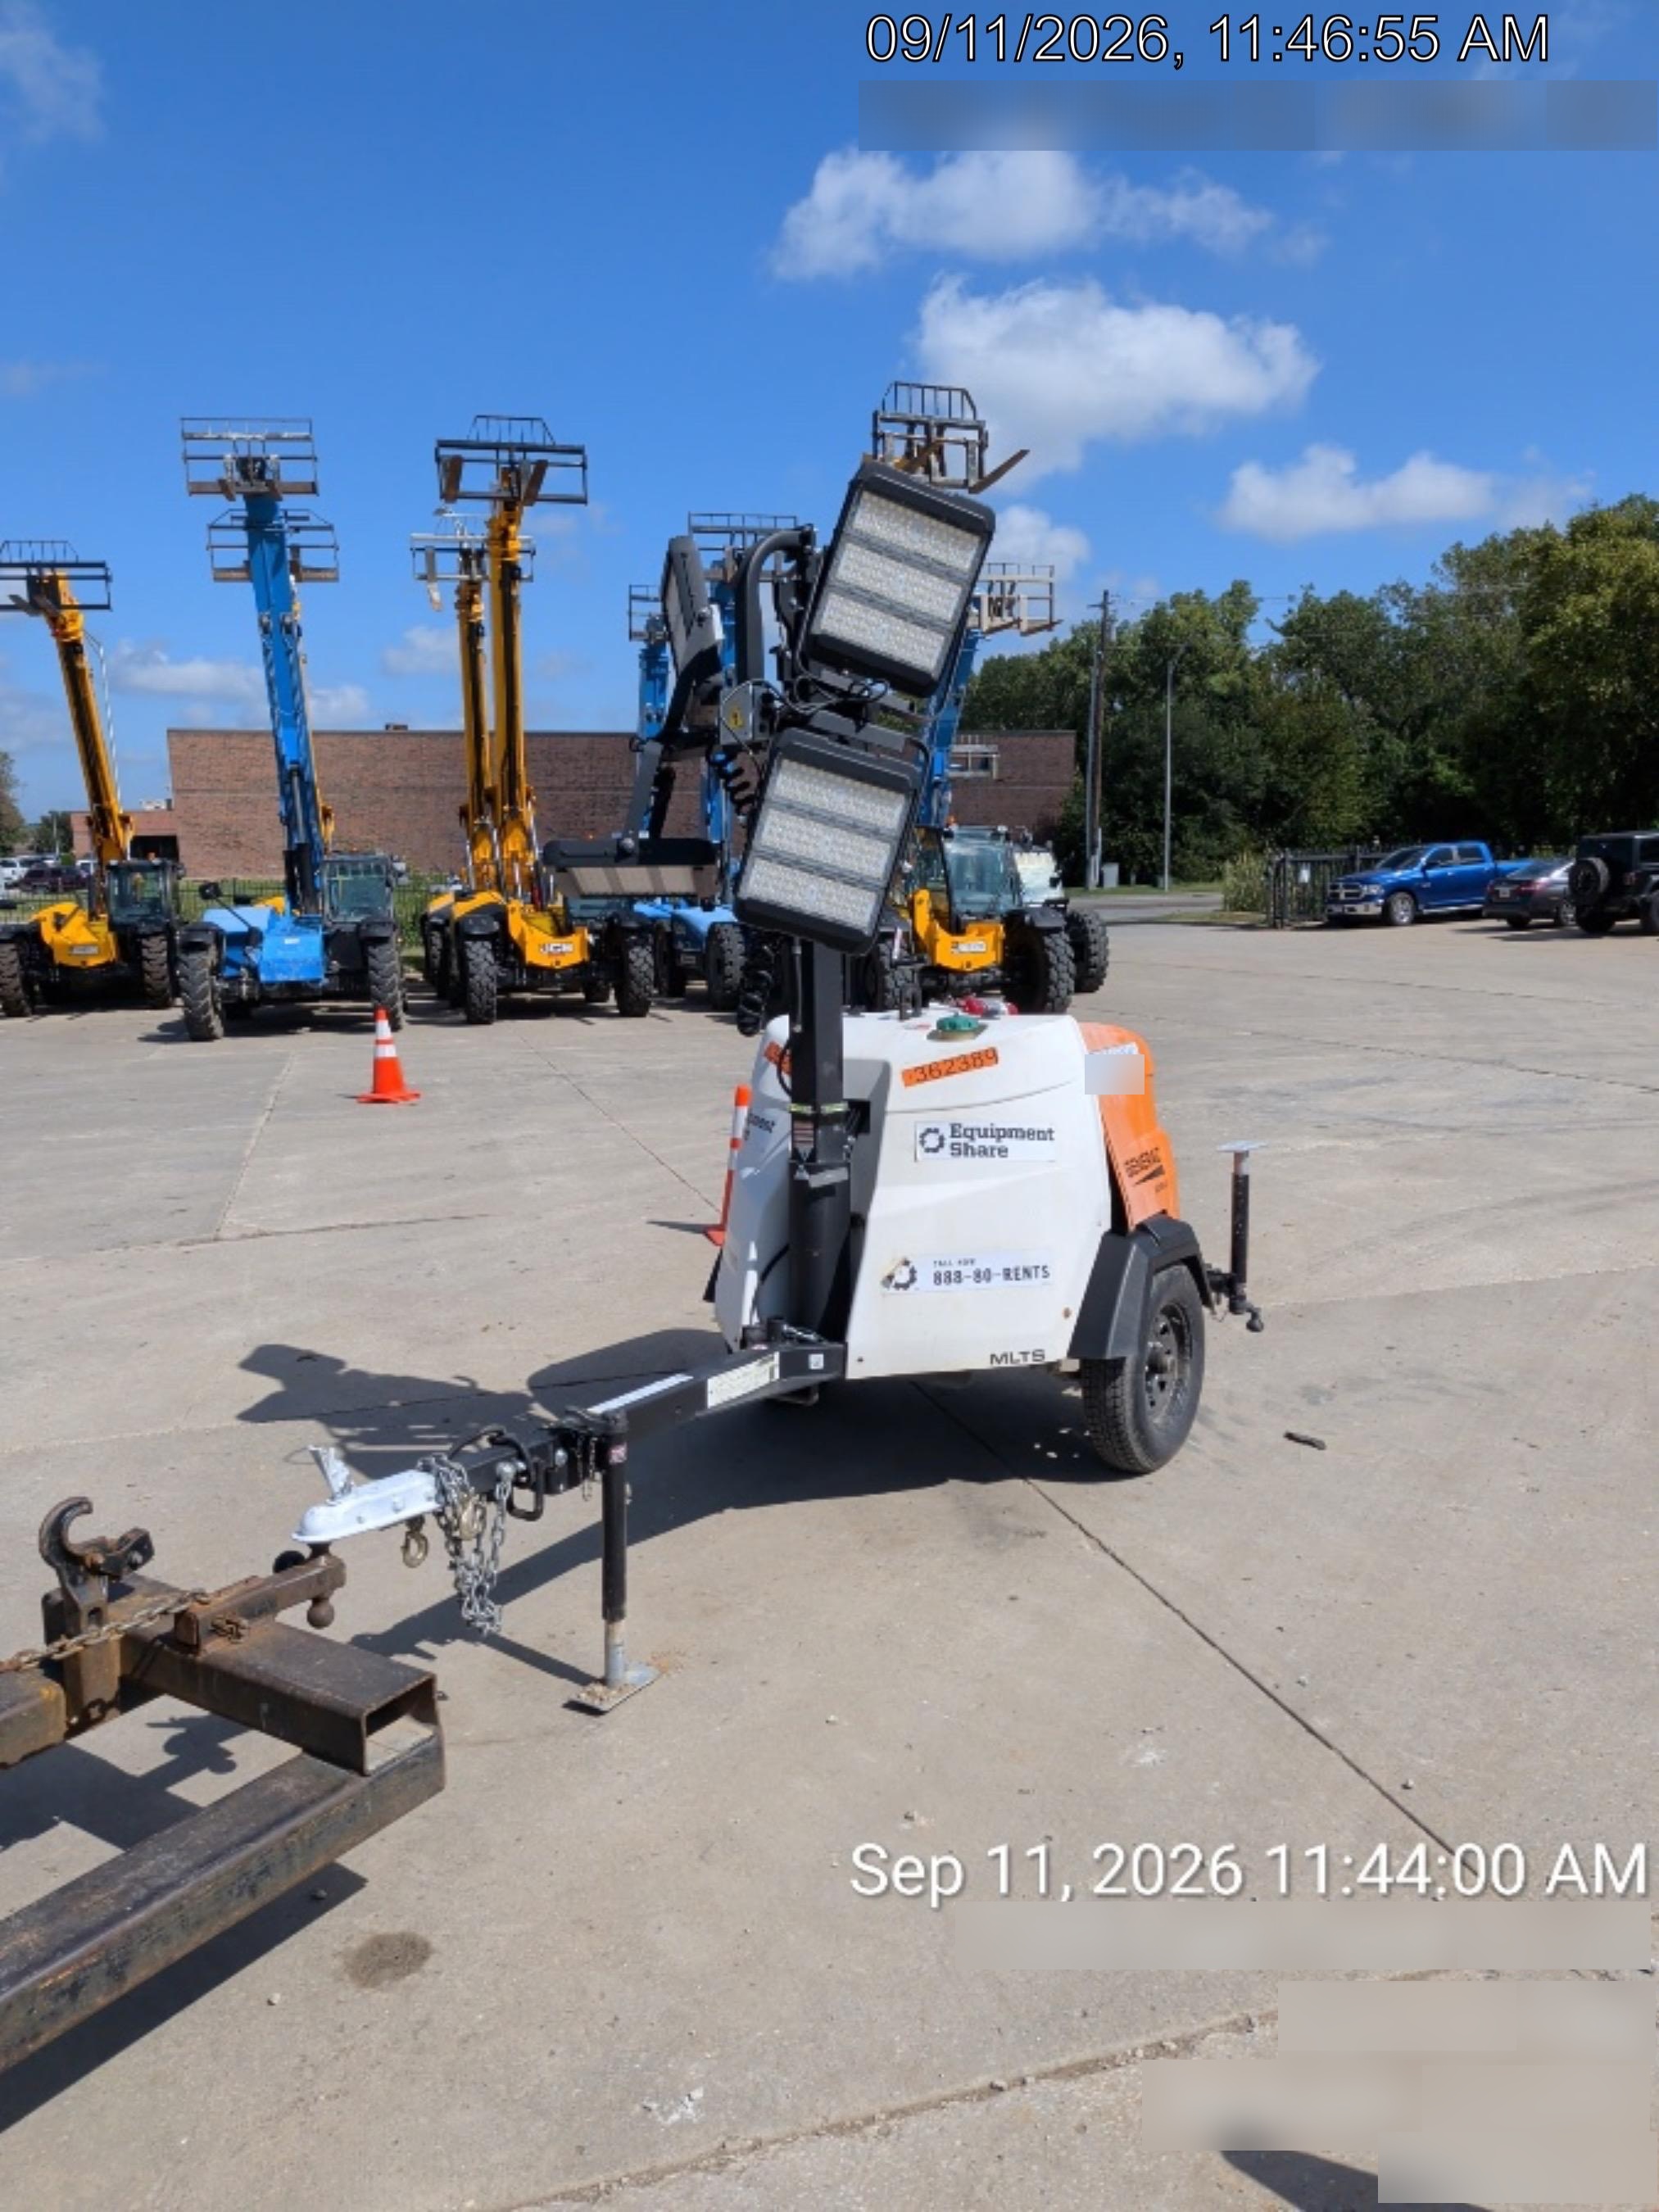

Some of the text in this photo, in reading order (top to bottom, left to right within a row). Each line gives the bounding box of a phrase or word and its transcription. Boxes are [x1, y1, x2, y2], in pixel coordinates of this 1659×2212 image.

[913, 1047, 999, 1083] 362389
[950, 1122, 1055, 1142] Equipment
[950, 1142, 1009, 1158] Share
[933, 1265, 1051, 1285] 888-80-RENTS
[989, 1348, 1045, 1365] MLTS
